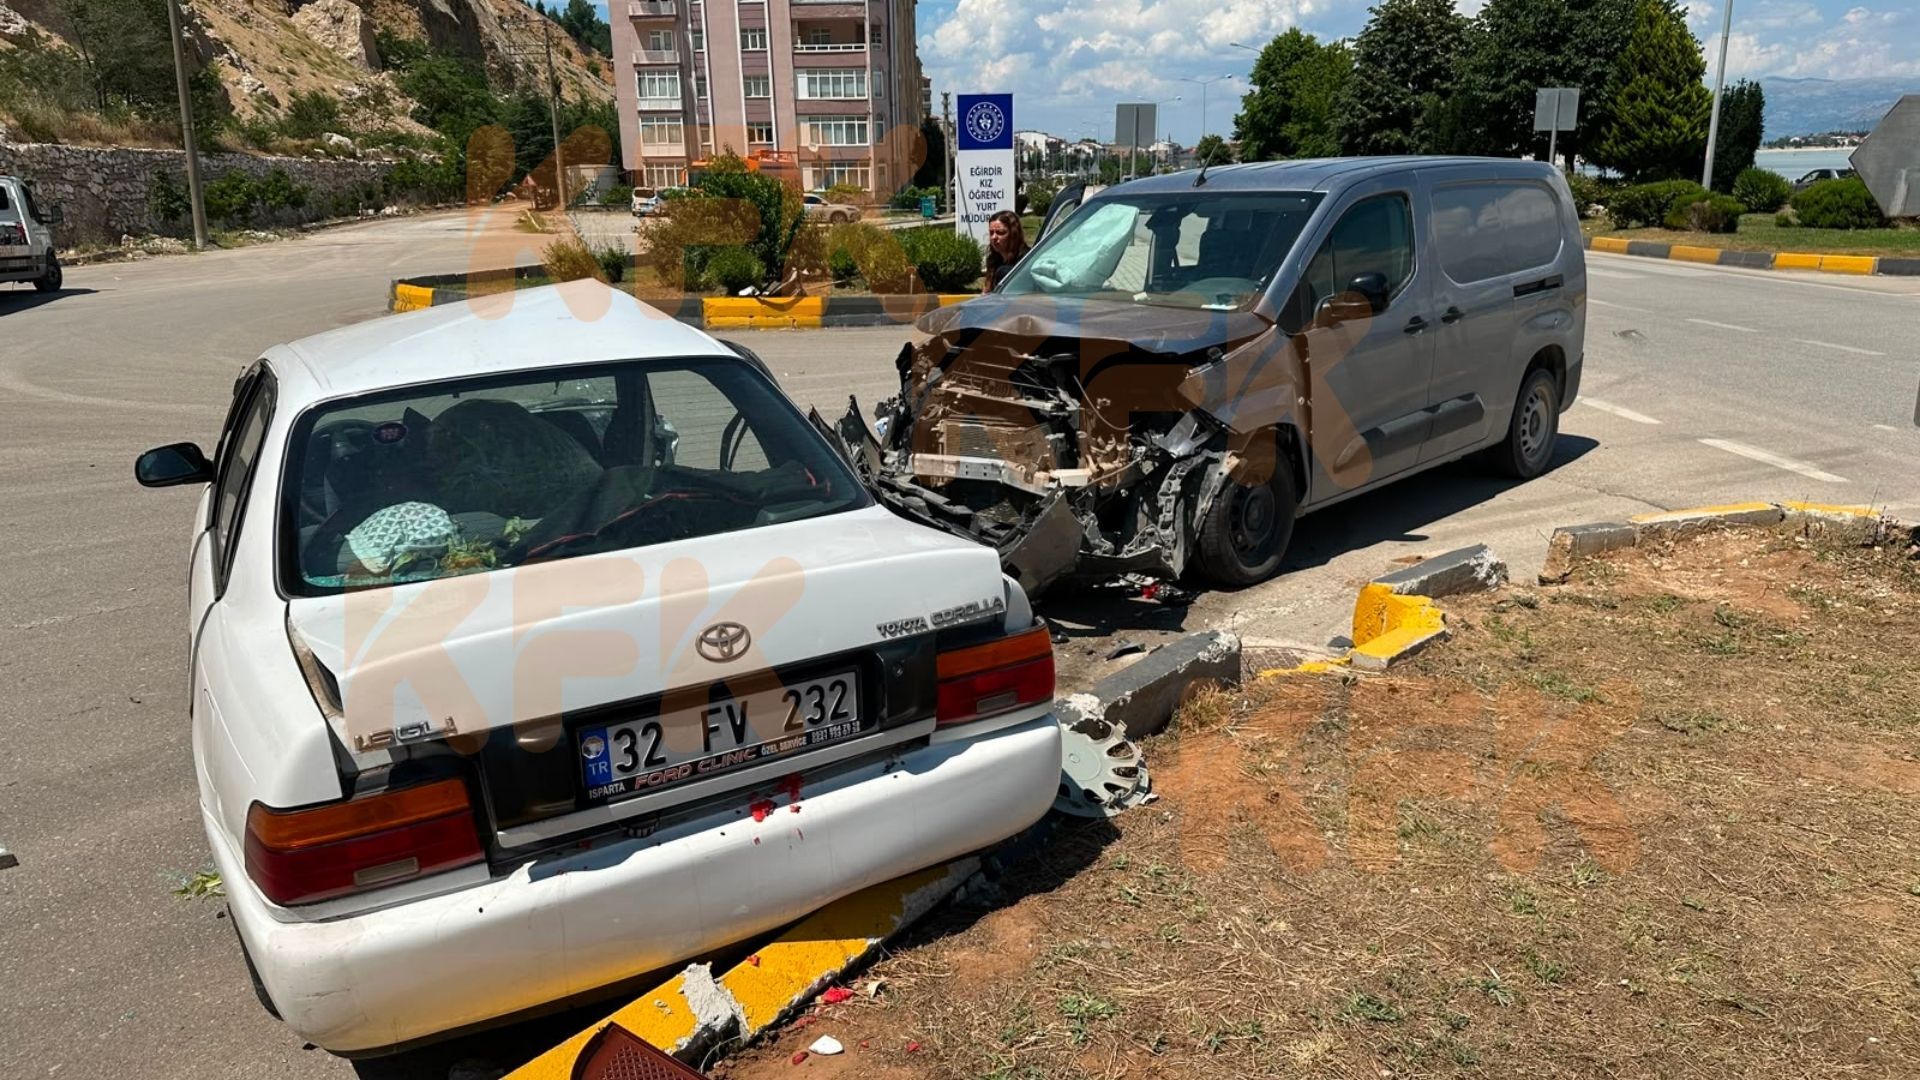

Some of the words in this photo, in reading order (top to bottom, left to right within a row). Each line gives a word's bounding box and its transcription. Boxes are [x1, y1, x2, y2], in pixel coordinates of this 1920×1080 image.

[970, 165, 1003, 176] EĞİRDİR
[979, 179, 993, 188] KIZ
[968, 190, 1004, 200] ÖĞRENCİ
[976, 202, 997, 211] YURT
[961, 213, 990, 223] MÜDÜR
[876, 616, 930, 639] TOYOTA
[930, 596, 1004, 628] COROLLA
[613, 721, 666, 774] 32
[701, 701, 749, 752] FV
[782, 679, 850, 733] 232
[588, 761, 608, 777] TR
[588, 783, 625, 799] ISPARTA
[634, 763, 692, 791] FORD
[697, 748, 757, 773] CLINIC
